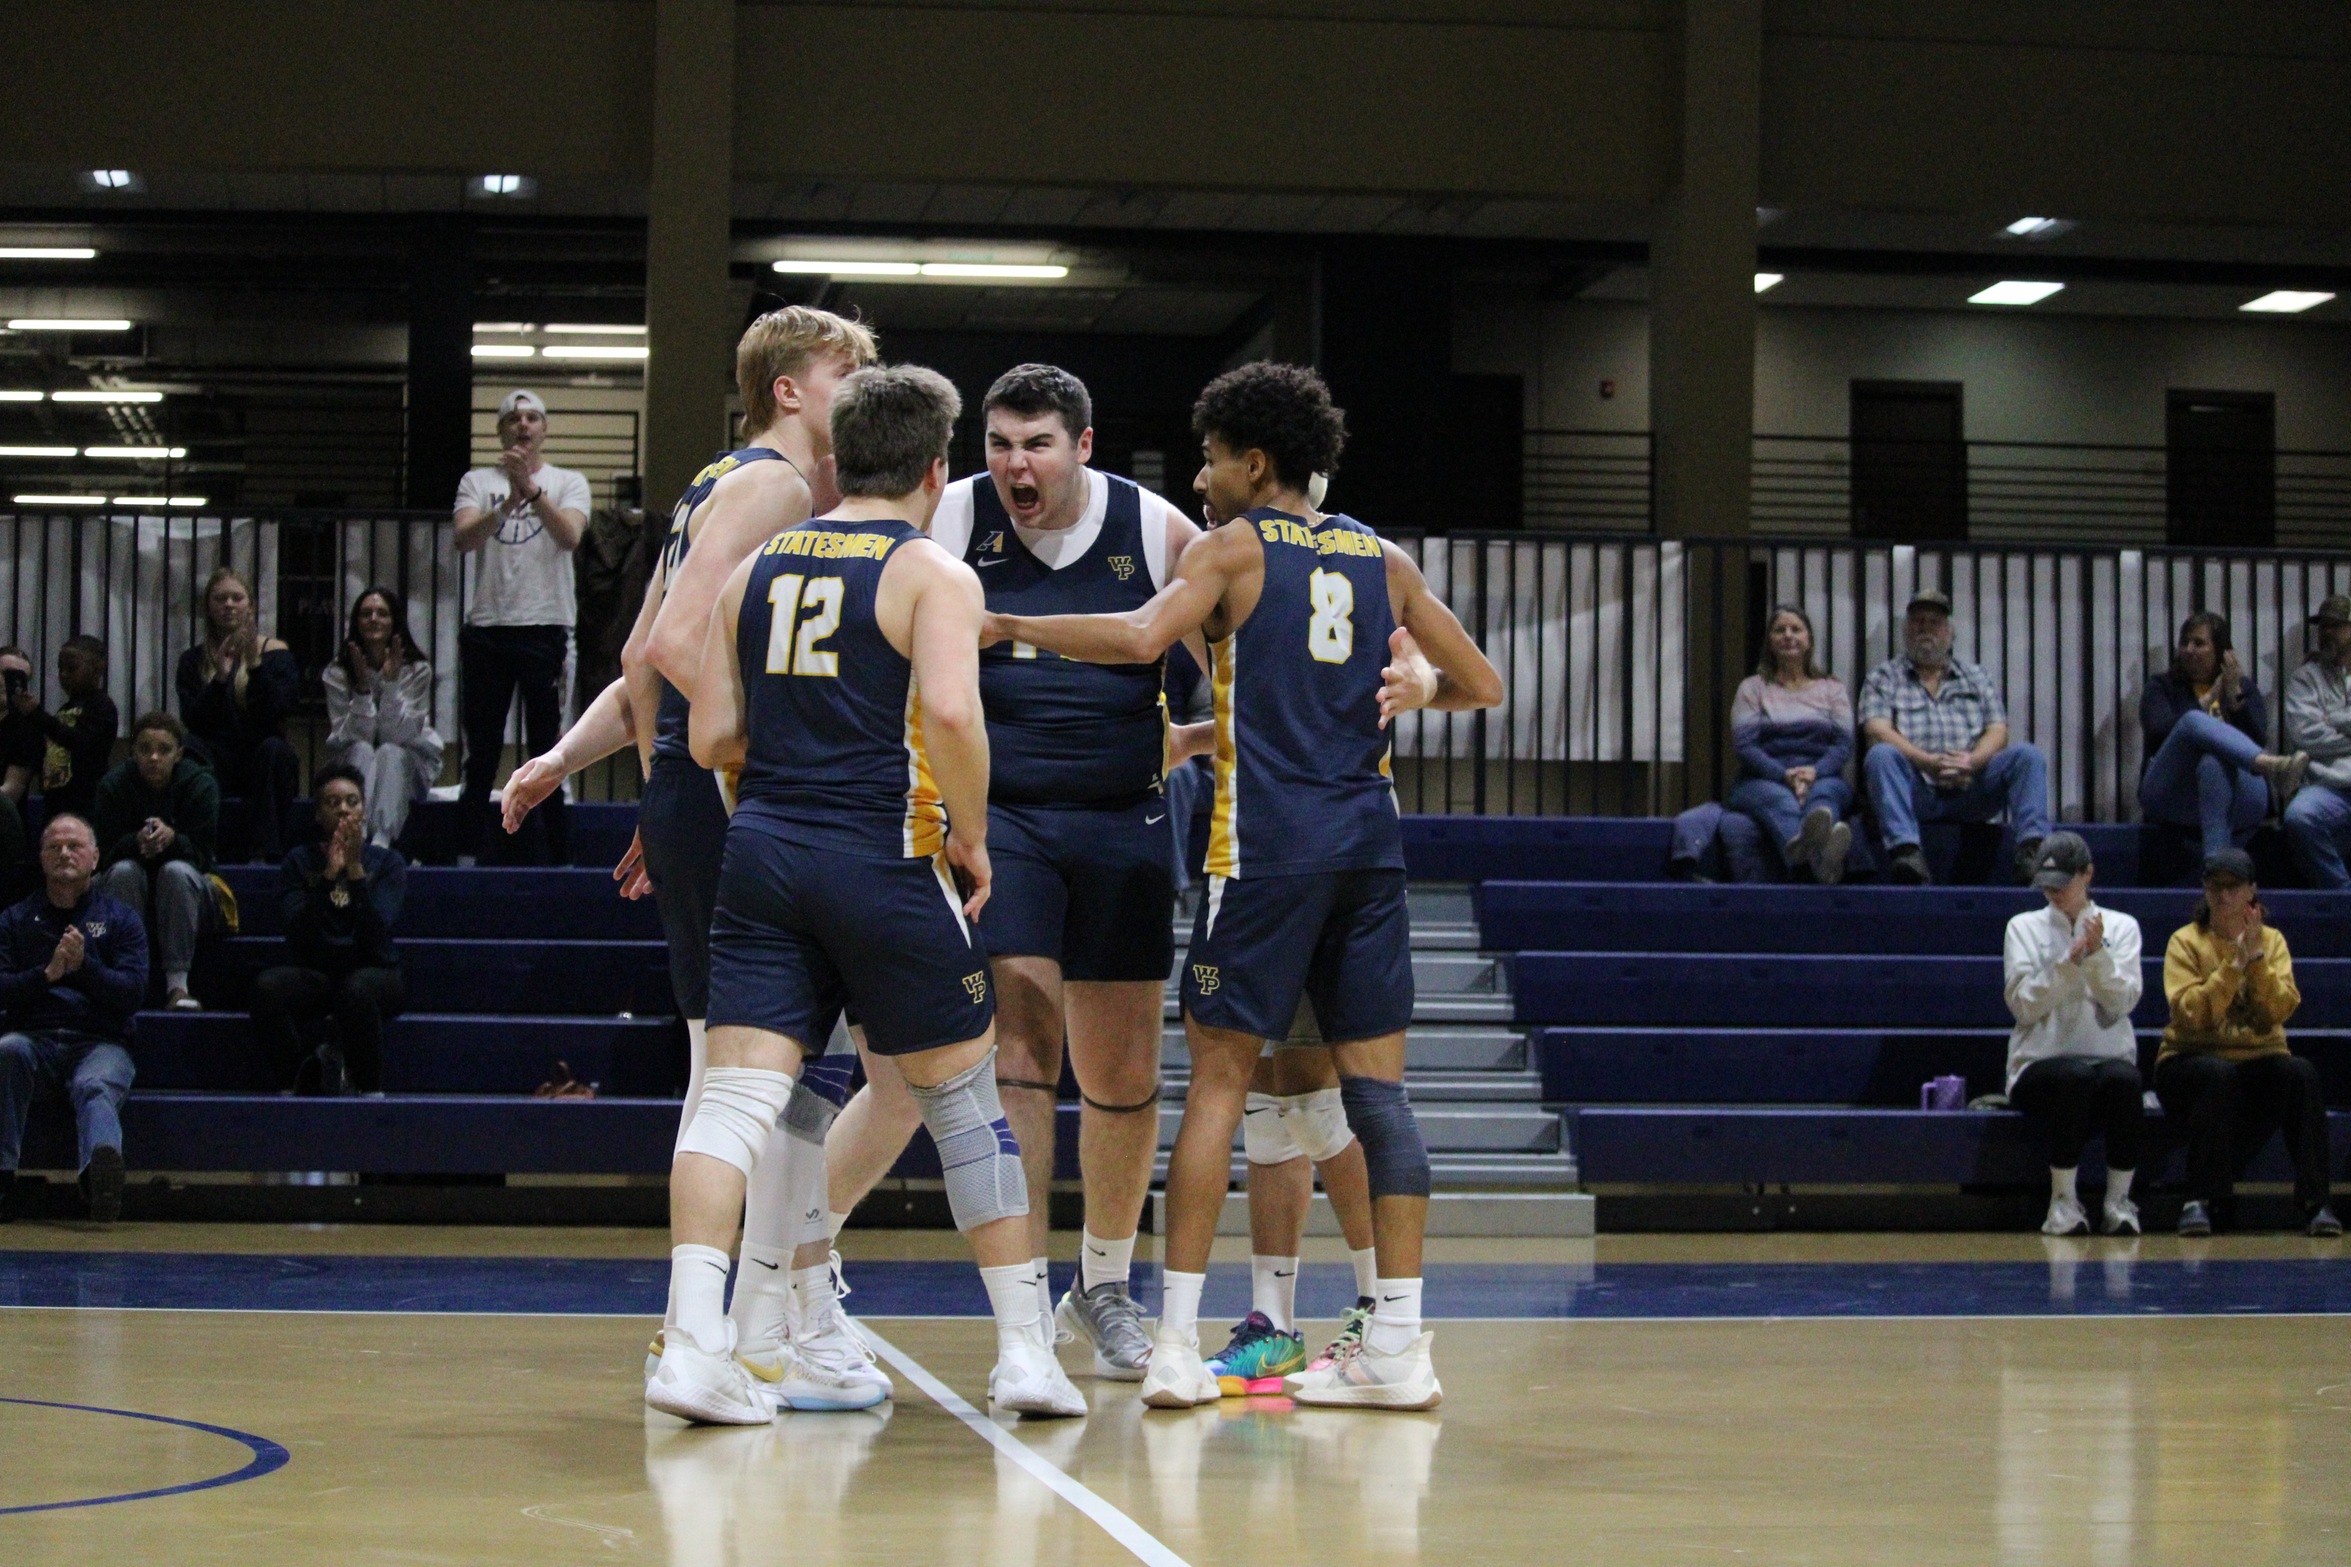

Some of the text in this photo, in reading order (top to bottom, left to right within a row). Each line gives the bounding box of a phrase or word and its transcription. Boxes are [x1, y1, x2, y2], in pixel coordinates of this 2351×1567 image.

[763, 530, 895, 561] STATESMEN
[1259, 519, 1382, 558] STATSMEN
[765, 573, 845, 678] 12
[1308, 566, 1354, 665] 8
